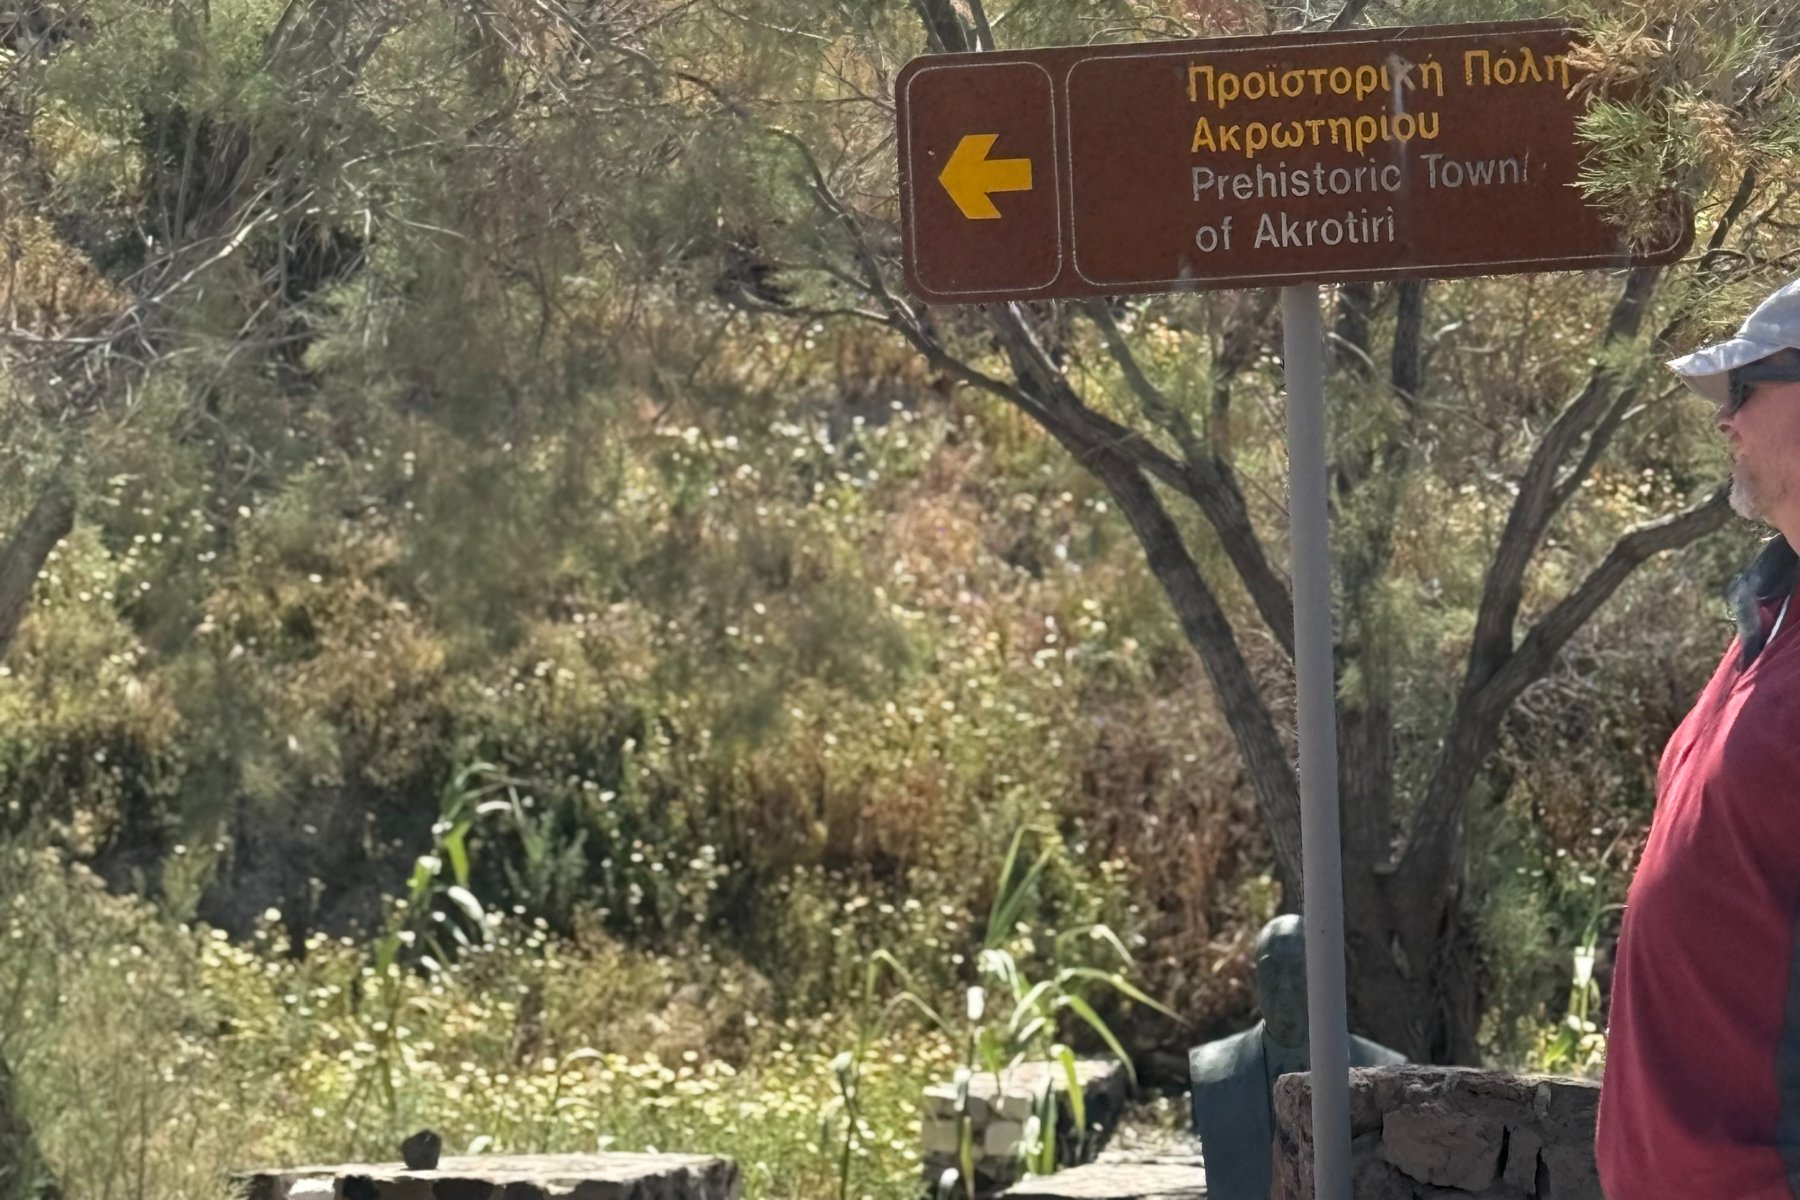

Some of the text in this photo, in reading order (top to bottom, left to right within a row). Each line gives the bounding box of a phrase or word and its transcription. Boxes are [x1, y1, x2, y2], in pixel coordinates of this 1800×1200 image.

[1187, 47, 1571, 108] Προϊστορική Πόλη
[1191, 105, 1440, 158] Ακρωτηρίου
[1192, 153, 1522, 202] Prehistoric Town
[1196, 206, 1395, 253] of Akrotiri
